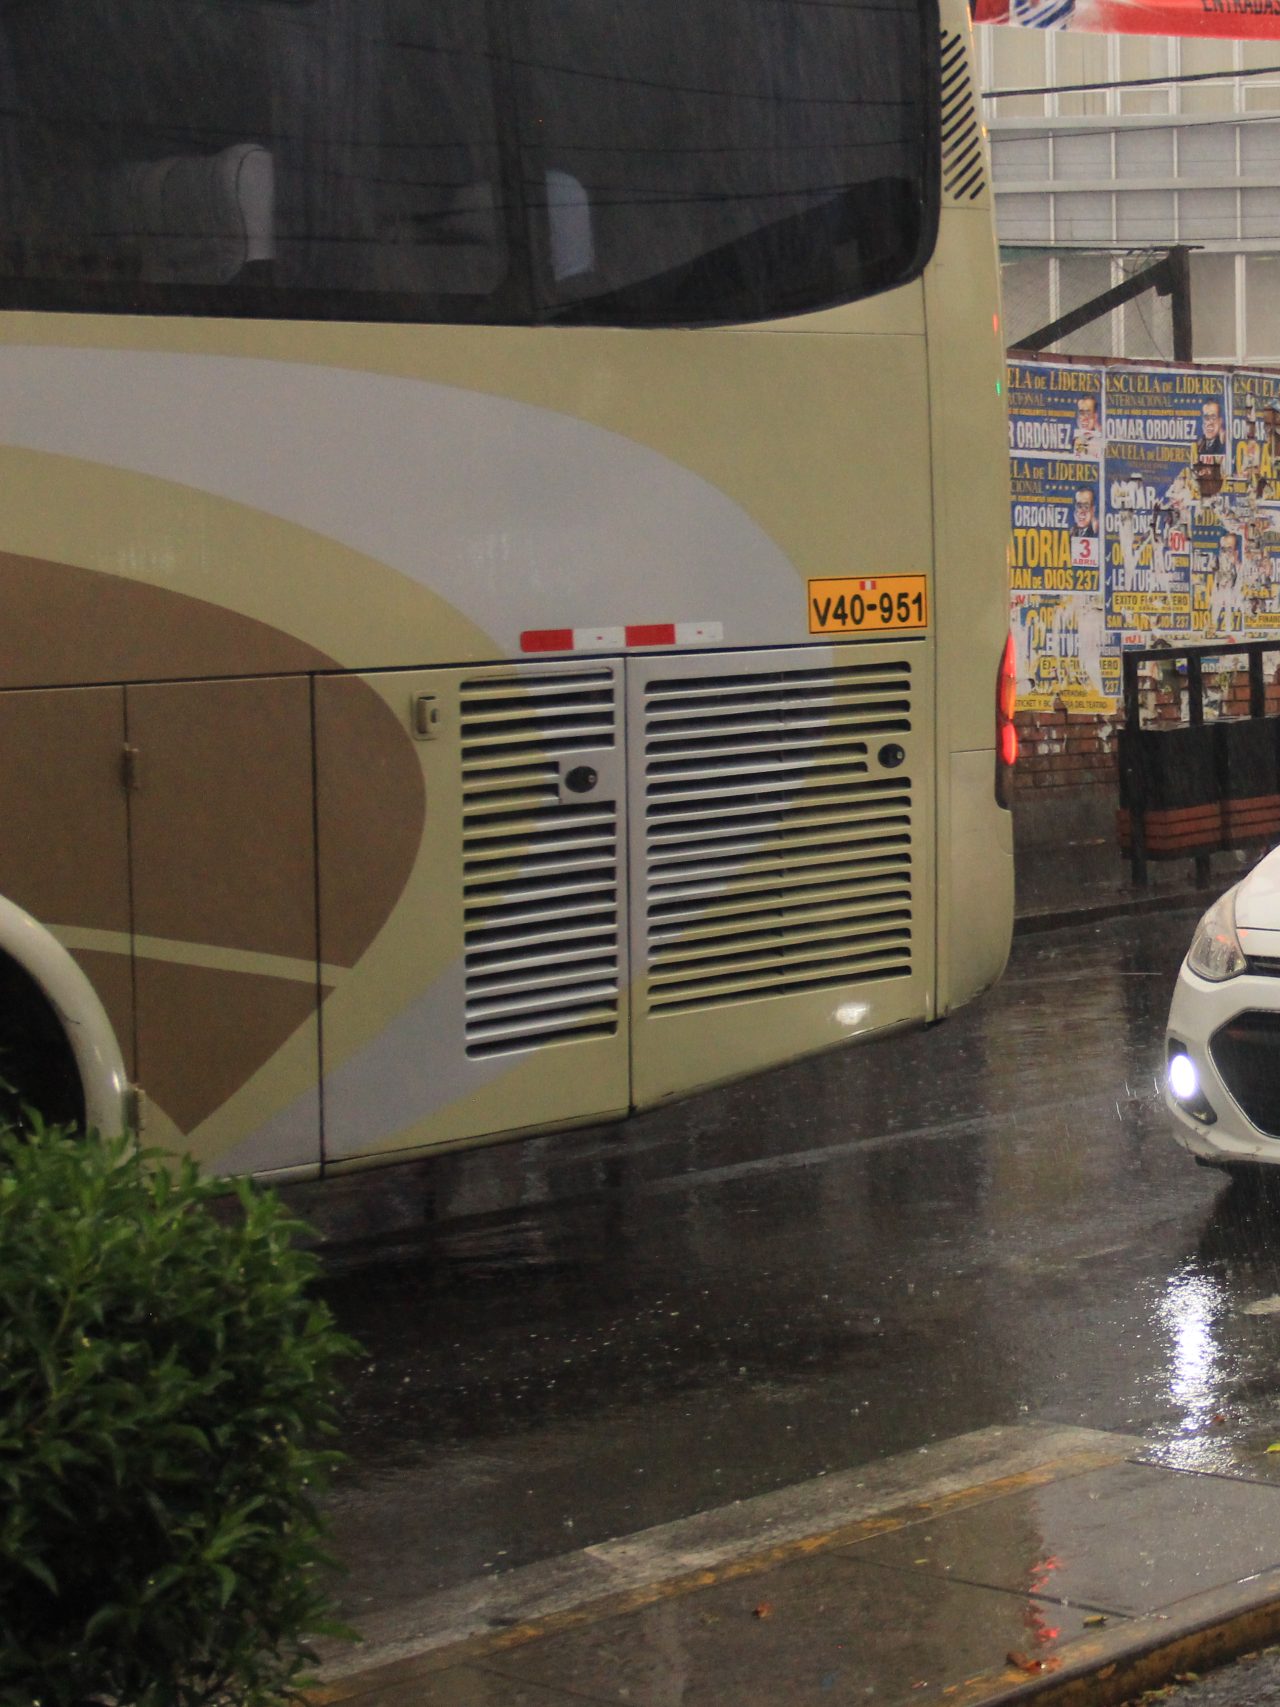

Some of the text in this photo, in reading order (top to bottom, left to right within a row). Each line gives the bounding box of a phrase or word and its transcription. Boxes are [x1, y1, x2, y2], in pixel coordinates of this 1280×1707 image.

[1034, 376, 1047, 390] DE
[1049, 368, 1101, 393] LÍDERES
[1106, 373, 1224, 395] ESCUELA DE LÍDERES
[1016, 418, 1073, 450] ORDÓÑEZ
[1106, 417, 1198, 441] OMAR ORDÓÑEZ
[1033, 467, 1044, 480] DE
[1047, 461, 1099, 481] LÍDERES
[1079, 539, 1092, 559] 3
[1073, 559, 1098, 567] ABRIL
[1044, 569, 1074, 590] DIOS
[1076, 569, 1099, 591] 237
[812, 592, 925, 628] V40-951
